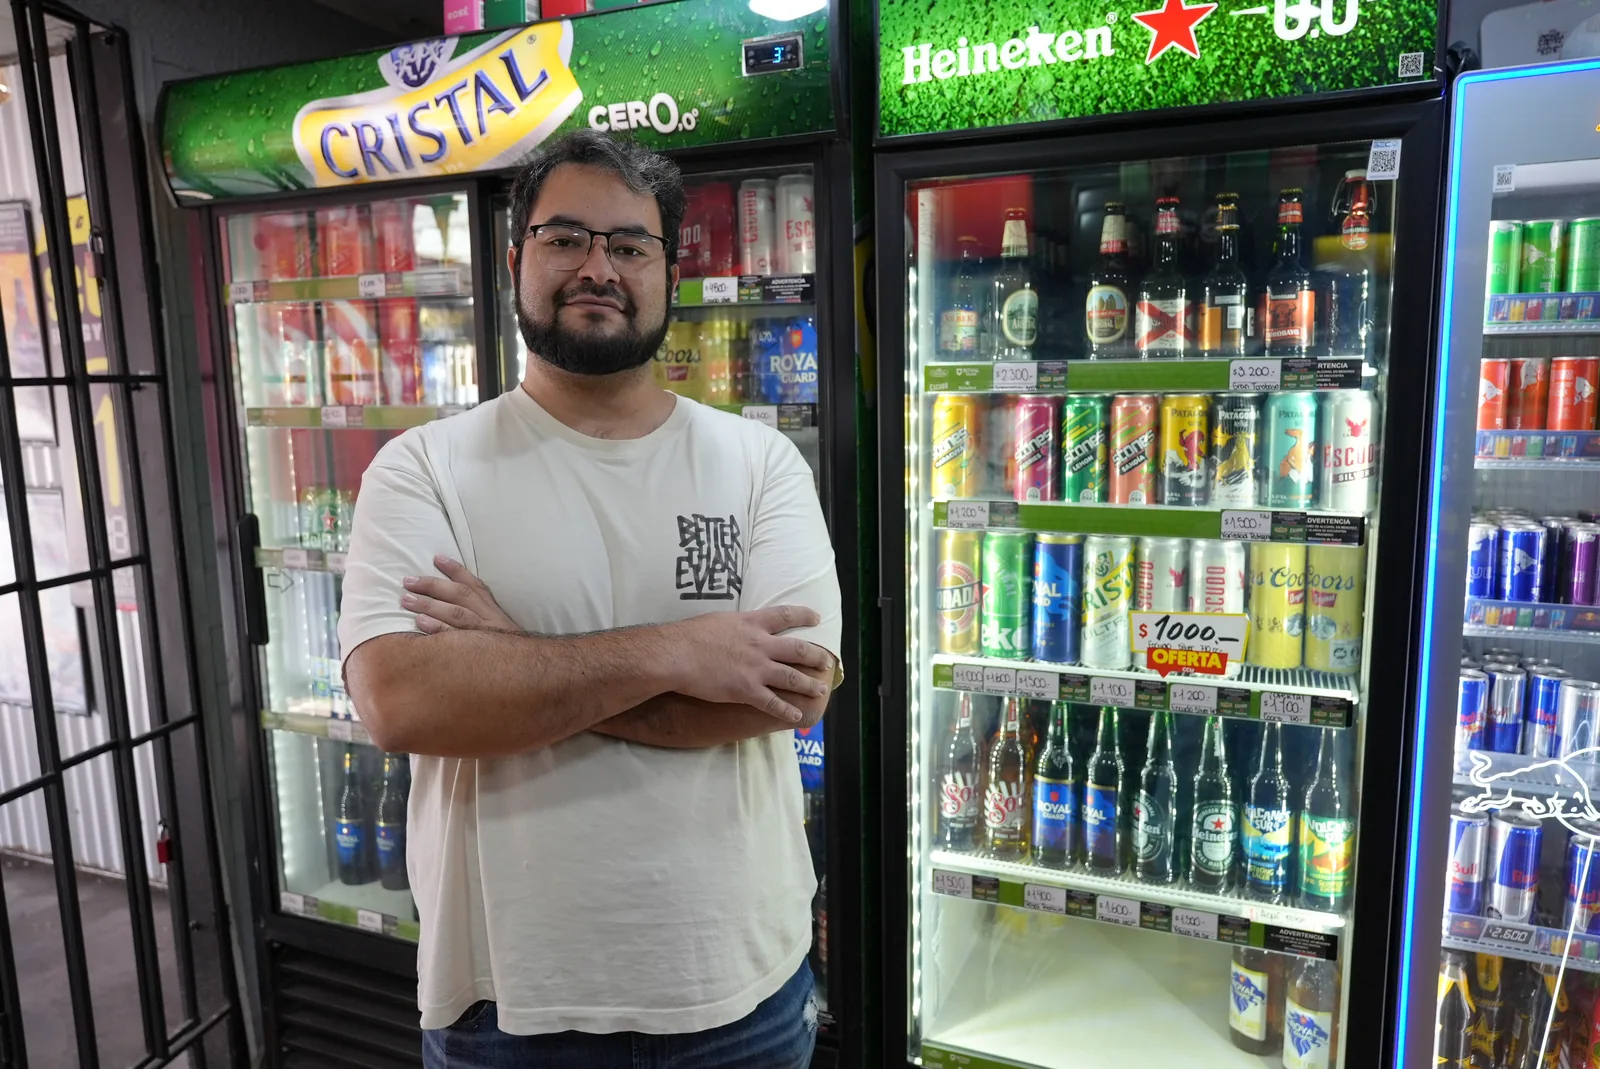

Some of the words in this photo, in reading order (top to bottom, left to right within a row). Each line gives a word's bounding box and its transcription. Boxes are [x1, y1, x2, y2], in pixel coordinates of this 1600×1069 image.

[901, 26, 1115, 85] Heineken
[320, 48, 549, 181] CRISTAL
[743, 190, 758, 244] ESCUDO
[679, 224, 701, 247] DO
[786, 219, 814, 241] ESC
[781, 372, 818, 383] GUARD
[1064, 429, 1106, 465] stones
[1112, 429, 1156, 467] stones
[1324, 443, 1377, 468] ESCUD
[1072, 454, 1094, 472] LEMON
[677, 513, 743, 551] BETTER
[684, 545, 738, 573] THAN
[1139, 623, 1148, 639] $
[1152, 649, 1222, 669] OFERTA
[1279, 928, 1325, 941] ADVERTENCIA
